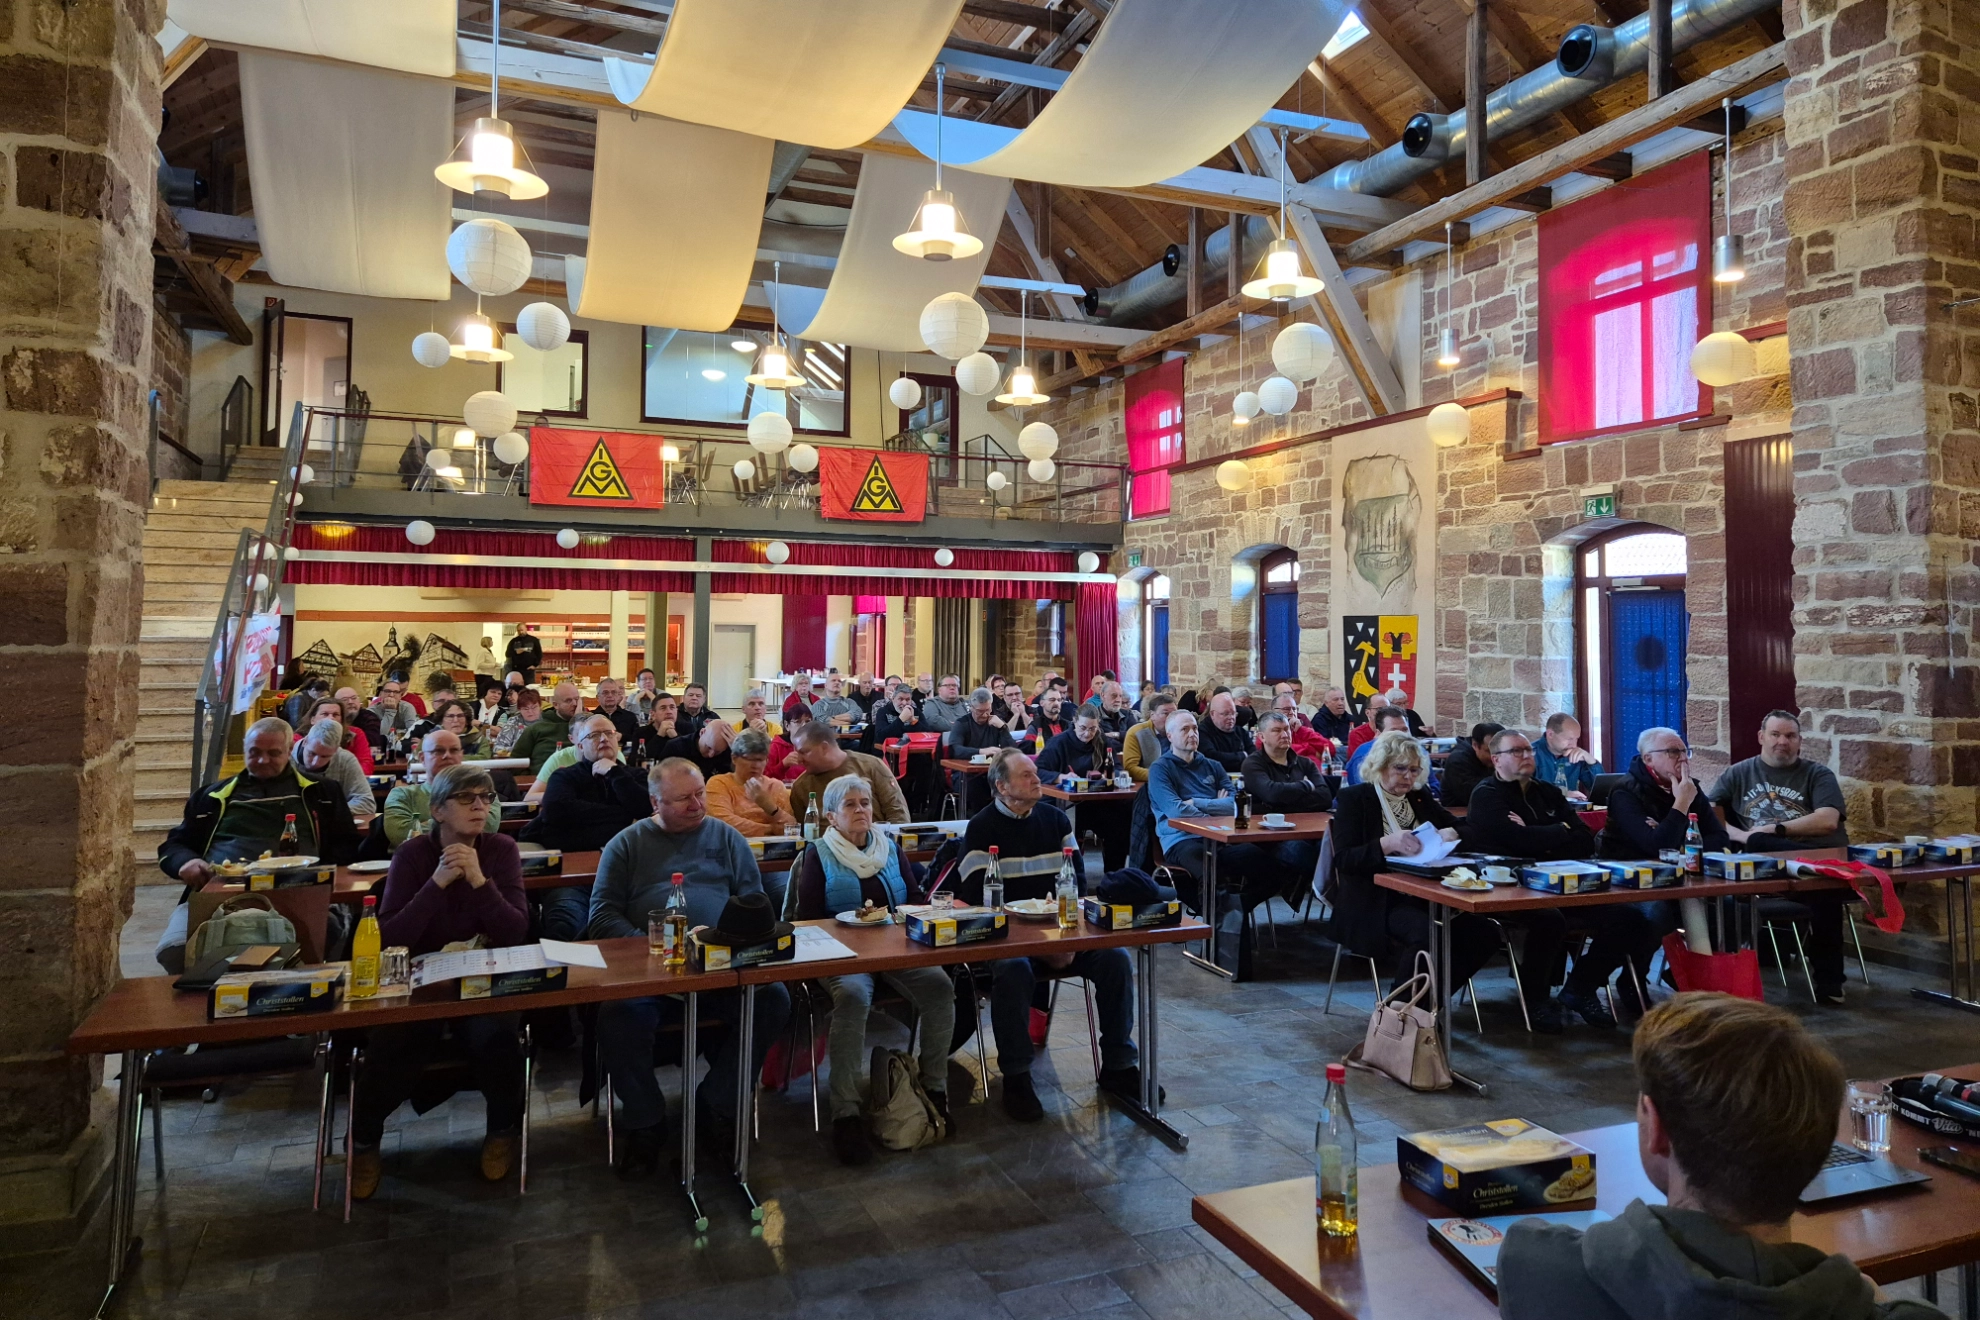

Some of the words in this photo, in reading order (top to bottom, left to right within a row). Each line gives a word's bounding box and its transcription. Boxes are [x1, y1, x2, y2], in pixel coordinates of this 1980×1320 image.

[256, 996, 305, 1006] Christstollen
[1900, 1108, 1931, 1125] KOMMT
[1931, 1117, 1963, 1135] Vita
[1473, 1184, 1519, 1199] Christstollen
